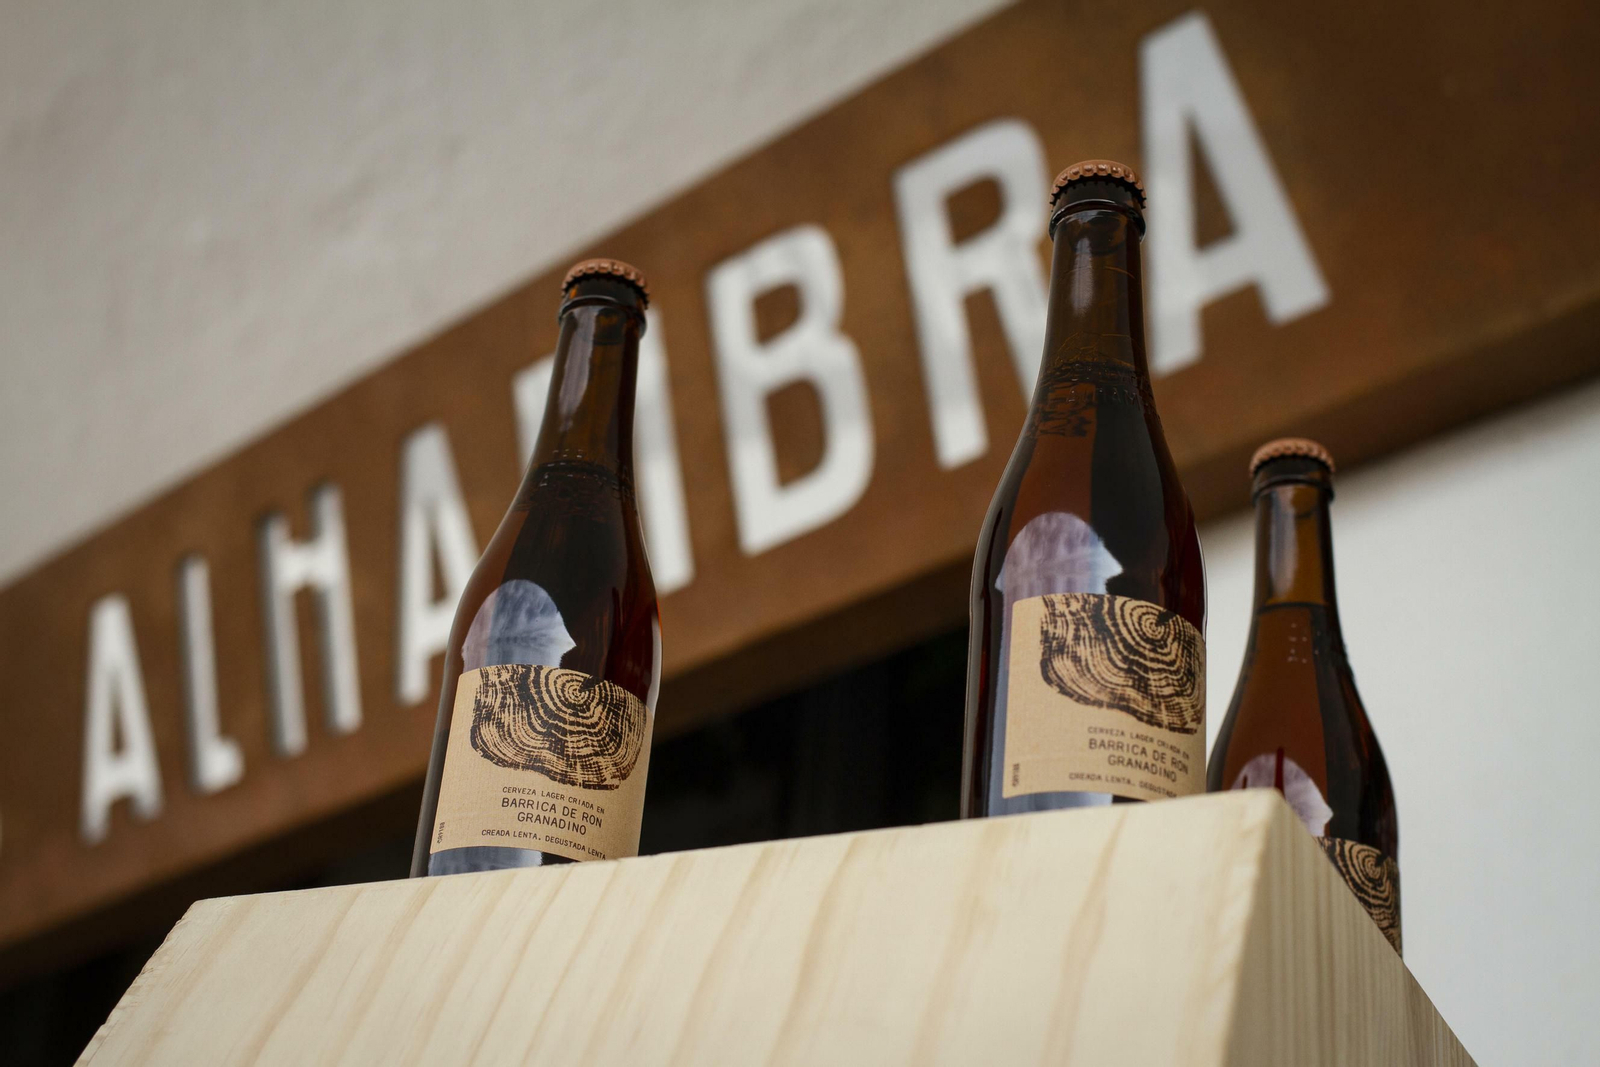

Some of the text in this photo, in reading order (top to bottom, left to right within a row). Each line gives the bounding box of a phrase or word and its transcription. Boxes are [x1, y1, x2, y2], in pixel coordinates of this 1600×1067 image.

[1088, 726, 1125, 737] CERVEZA
[1130, 731, 1154, 743] LAGER
[1157, 739, 1180, 754] CRIADA
[1088, 738, 1188, 775] BARRICA DE RON
[1107, 754, 1177, 783] GRANADINO
[1069, 772, 1102, 781] CREADA
[501, 797, 602, 828] BARRICA DE RON
[502, 786, 605, 814] CERVEZA LAGER CRIADA EN
[517, 811, 587, 836] GRANADINO
[481, 829, 510, 837] CREADA
[544, 835, 586, 852] DEGUSTADA
[587, 847, 606, 860] LENTA
